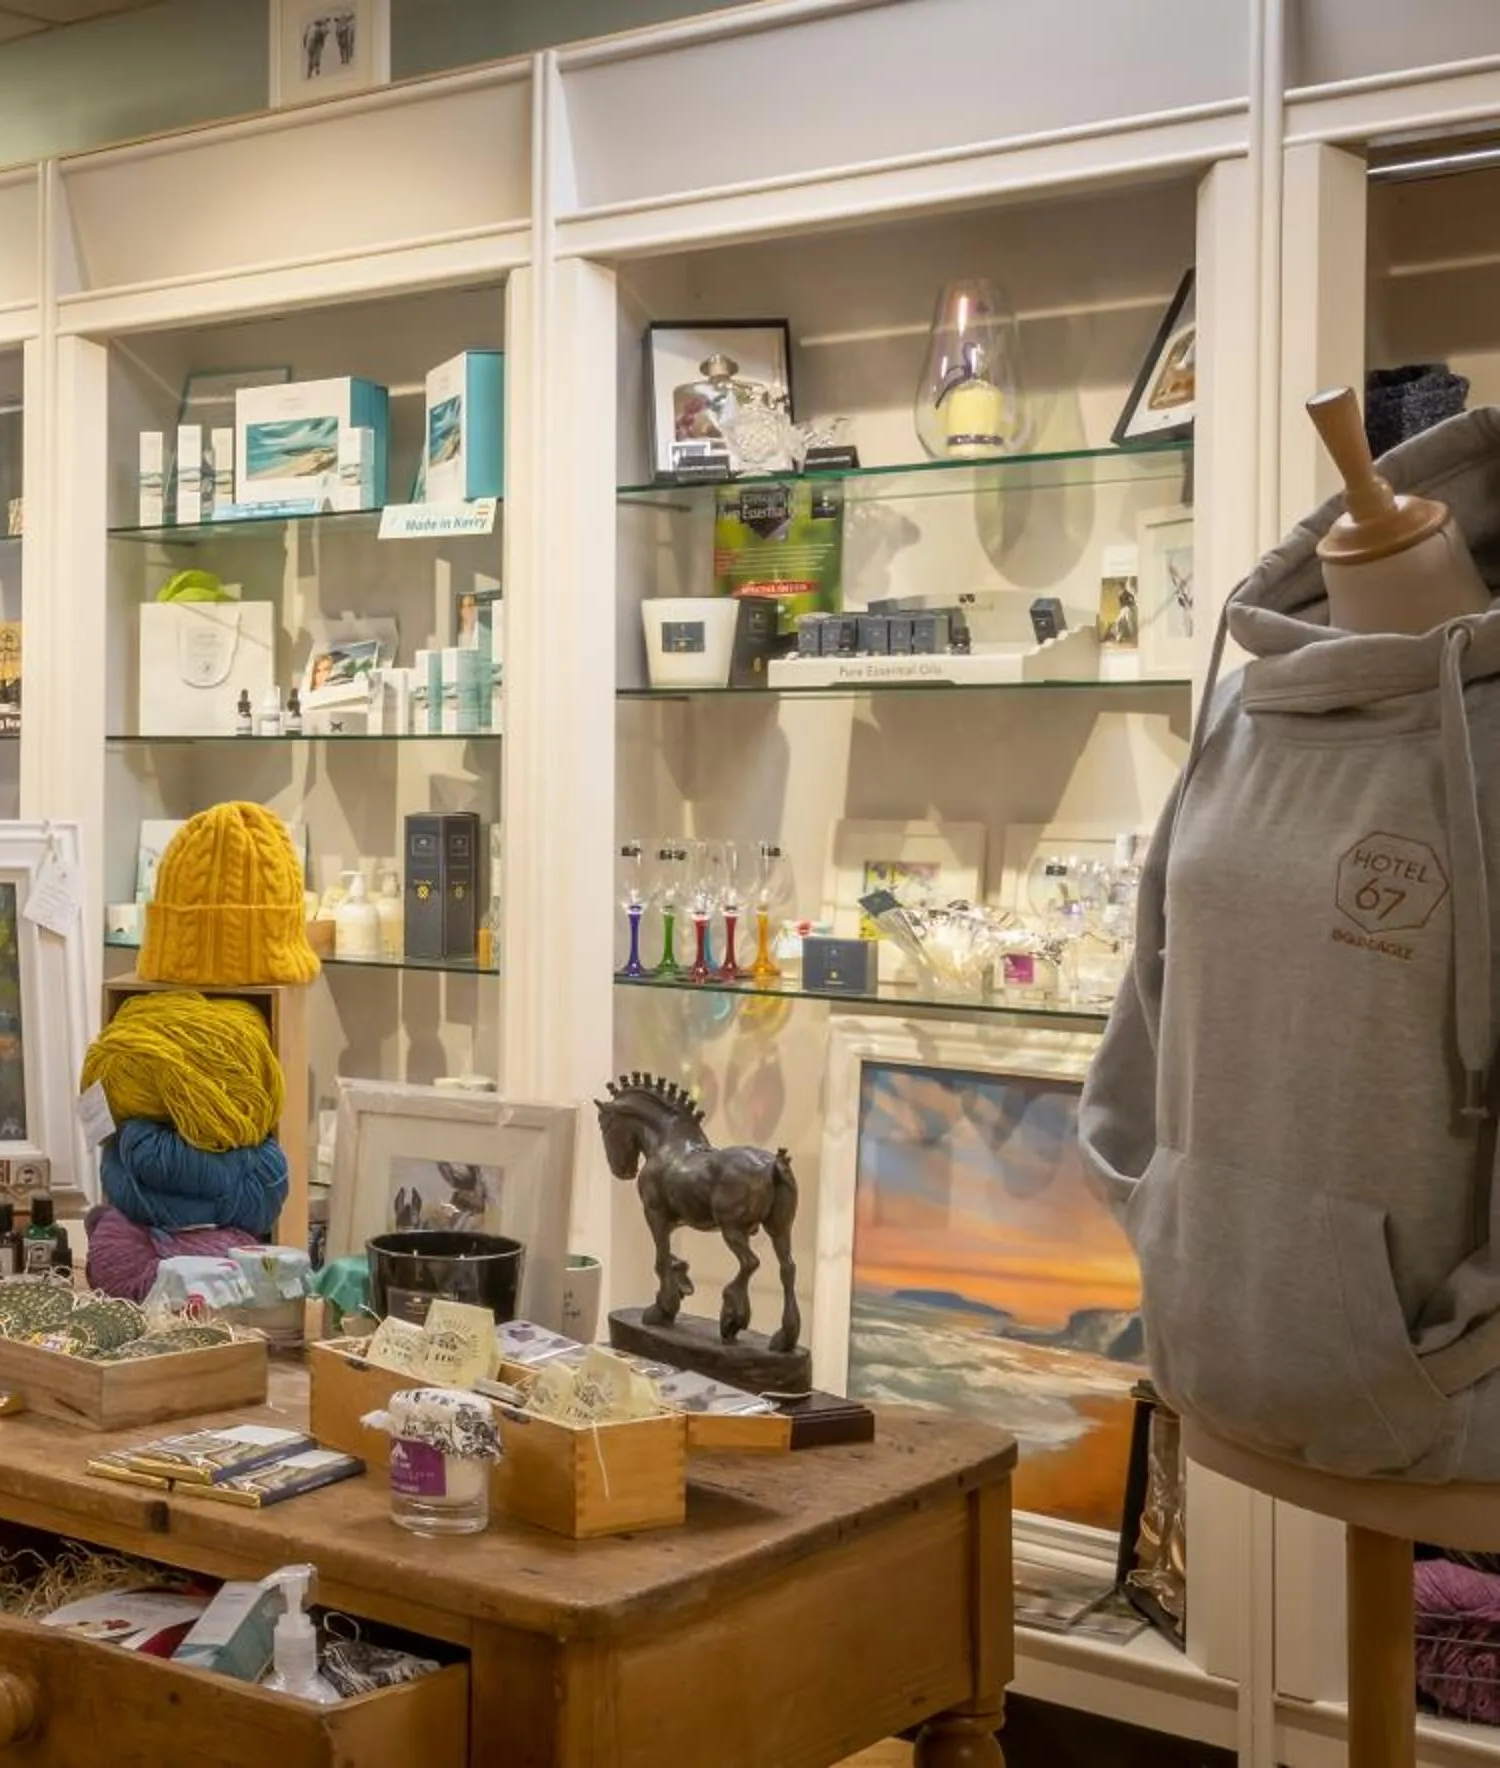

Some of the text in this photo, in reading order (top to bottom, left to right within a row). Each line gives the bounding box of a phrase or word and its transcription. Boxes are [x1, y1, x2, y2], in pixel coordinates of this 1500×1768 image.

[406, 519, 438, 531] Made
[440, 518, 452, 529] in
[1353, 848, 1429, 884] HOTEL
[1355, 878, 1407, 921] 67
